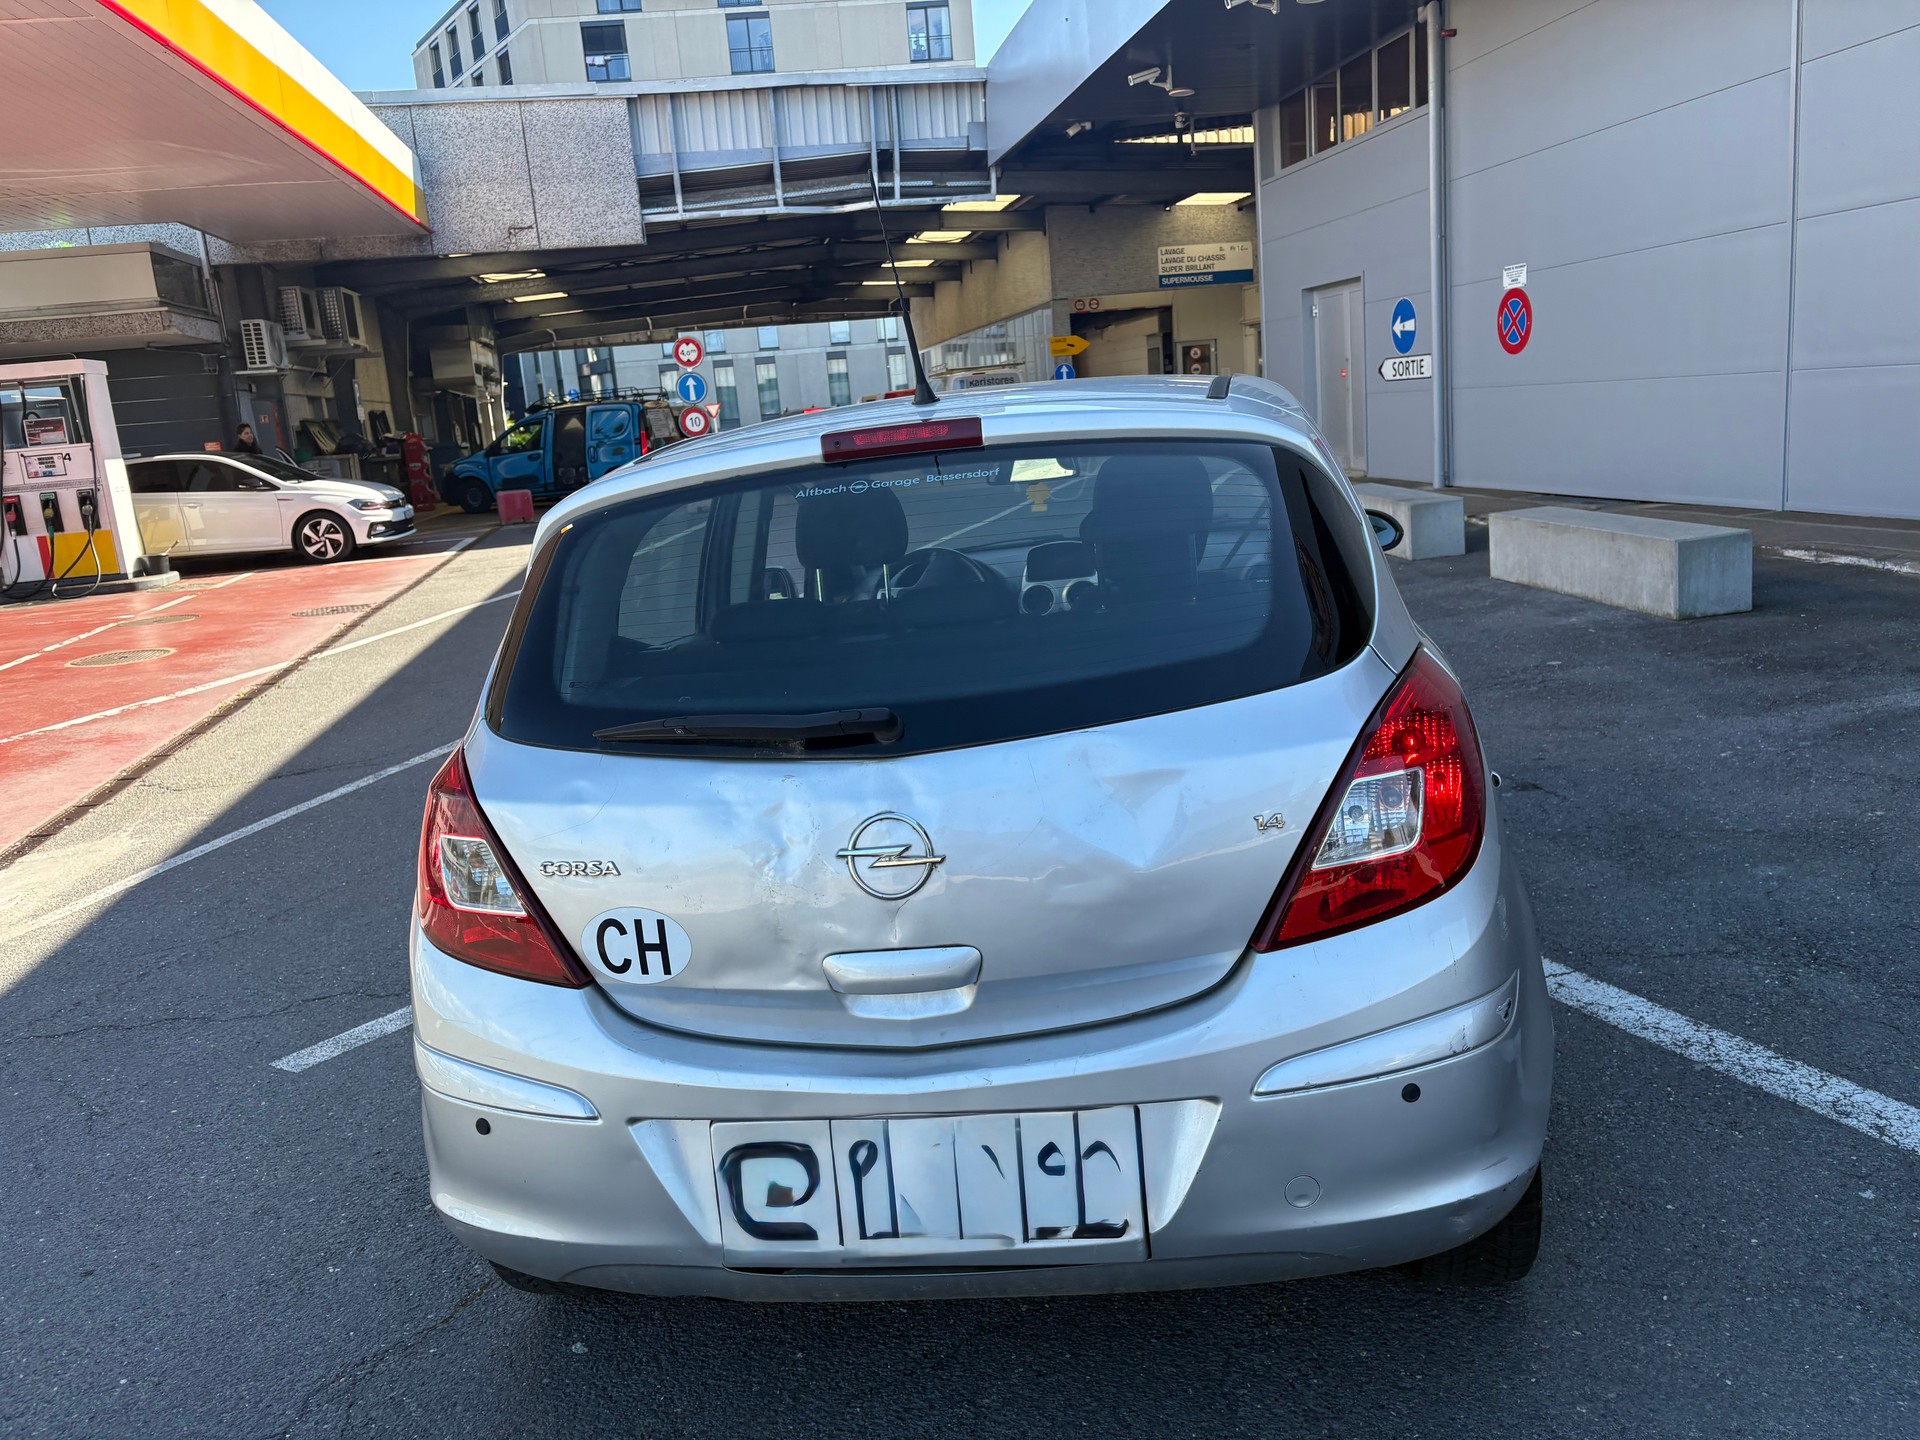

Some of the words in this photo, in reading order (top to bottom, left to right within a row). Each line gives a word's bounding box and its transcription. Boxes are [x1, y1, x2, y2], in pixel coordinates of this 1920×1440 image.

[1160, 248, 1185, 256] LAVAGE
[1197, 254, 1226, 262] CHASSIS
[1161, 266, 1183, 274] SUPER
[1161, 275, 1214, 285] SUPERMOUSSE
[1392, 358, 1425, 378] SORTIE
[689, 416, 701, 427] 10
[63, 453, 72, 461] 4
[795, 484, 847, 499] Altbach
[871, 476, 920, 491] Garage
[926, 467, 1000, 483] Bassersdorf
[539, 860, 622, 877] CORSA
[596, 917, 673, 976] CH
